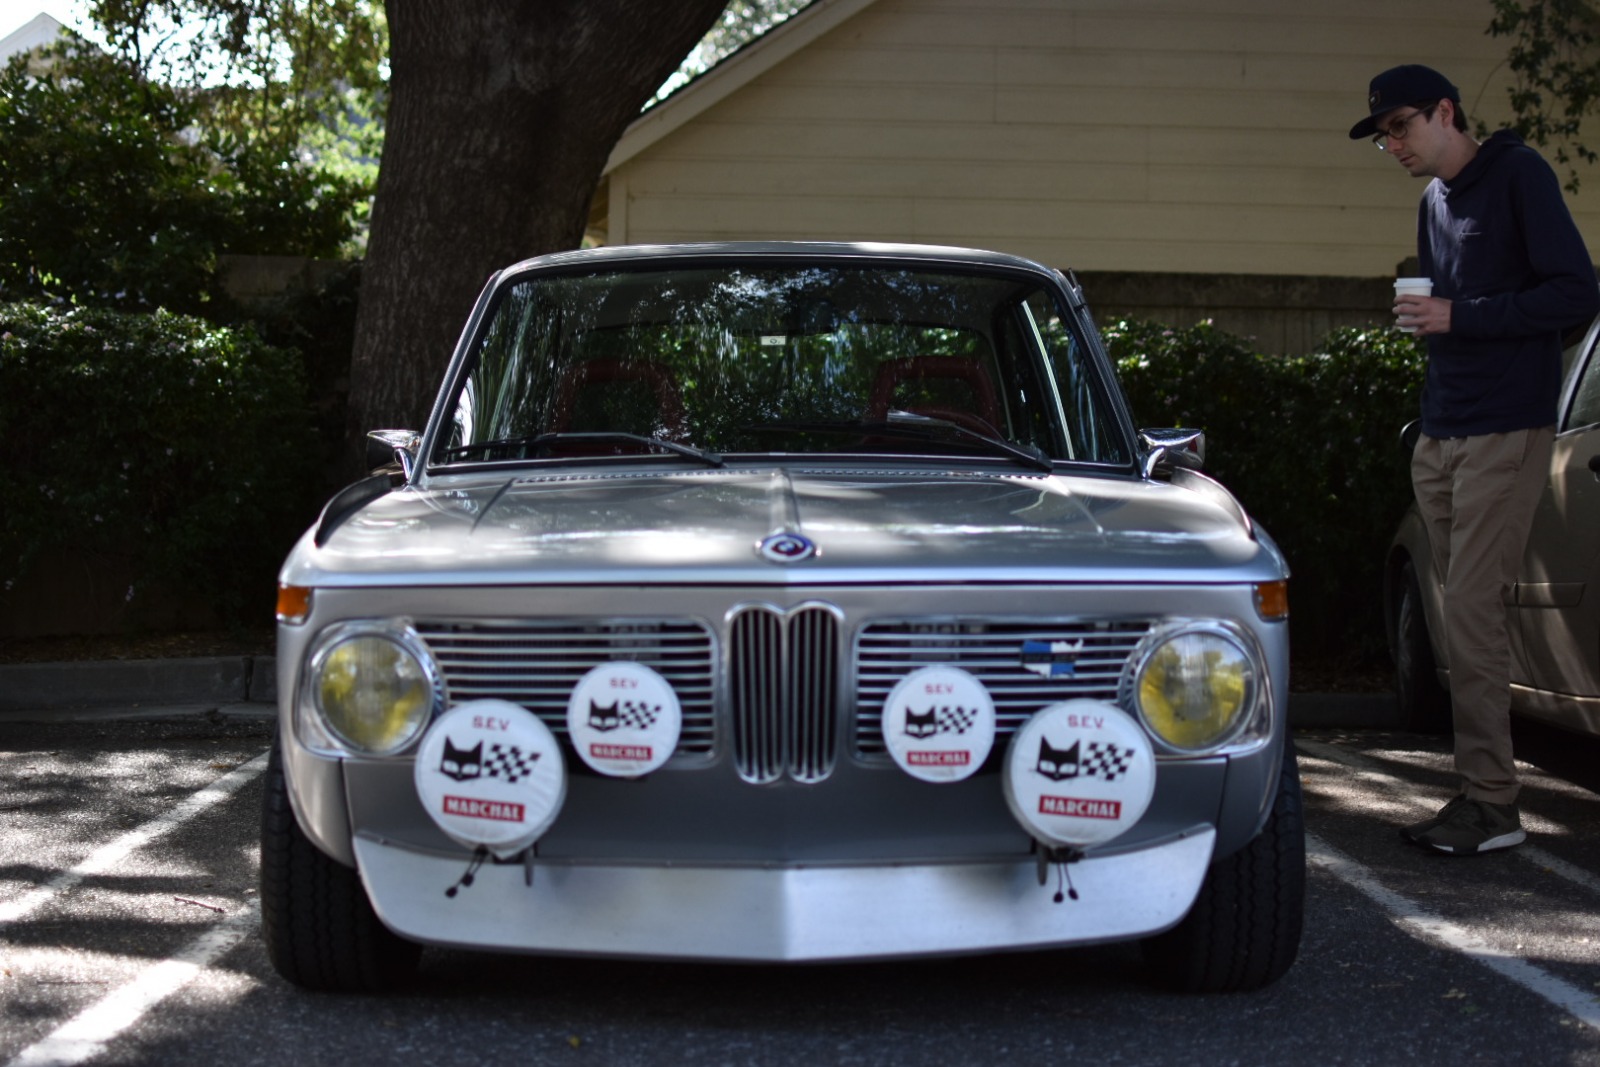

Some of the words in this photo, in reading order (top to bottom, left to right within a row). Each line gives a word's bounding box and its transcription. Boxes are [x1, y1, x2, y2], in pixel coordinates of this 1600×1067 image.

[592, 744, 651, 760] MARCHAL
[909, 751, 968, 765] MARCHAL
[447, 797, 521, 821] MARCHAL
[1042, 797, 1118, 818] MARCHAL
